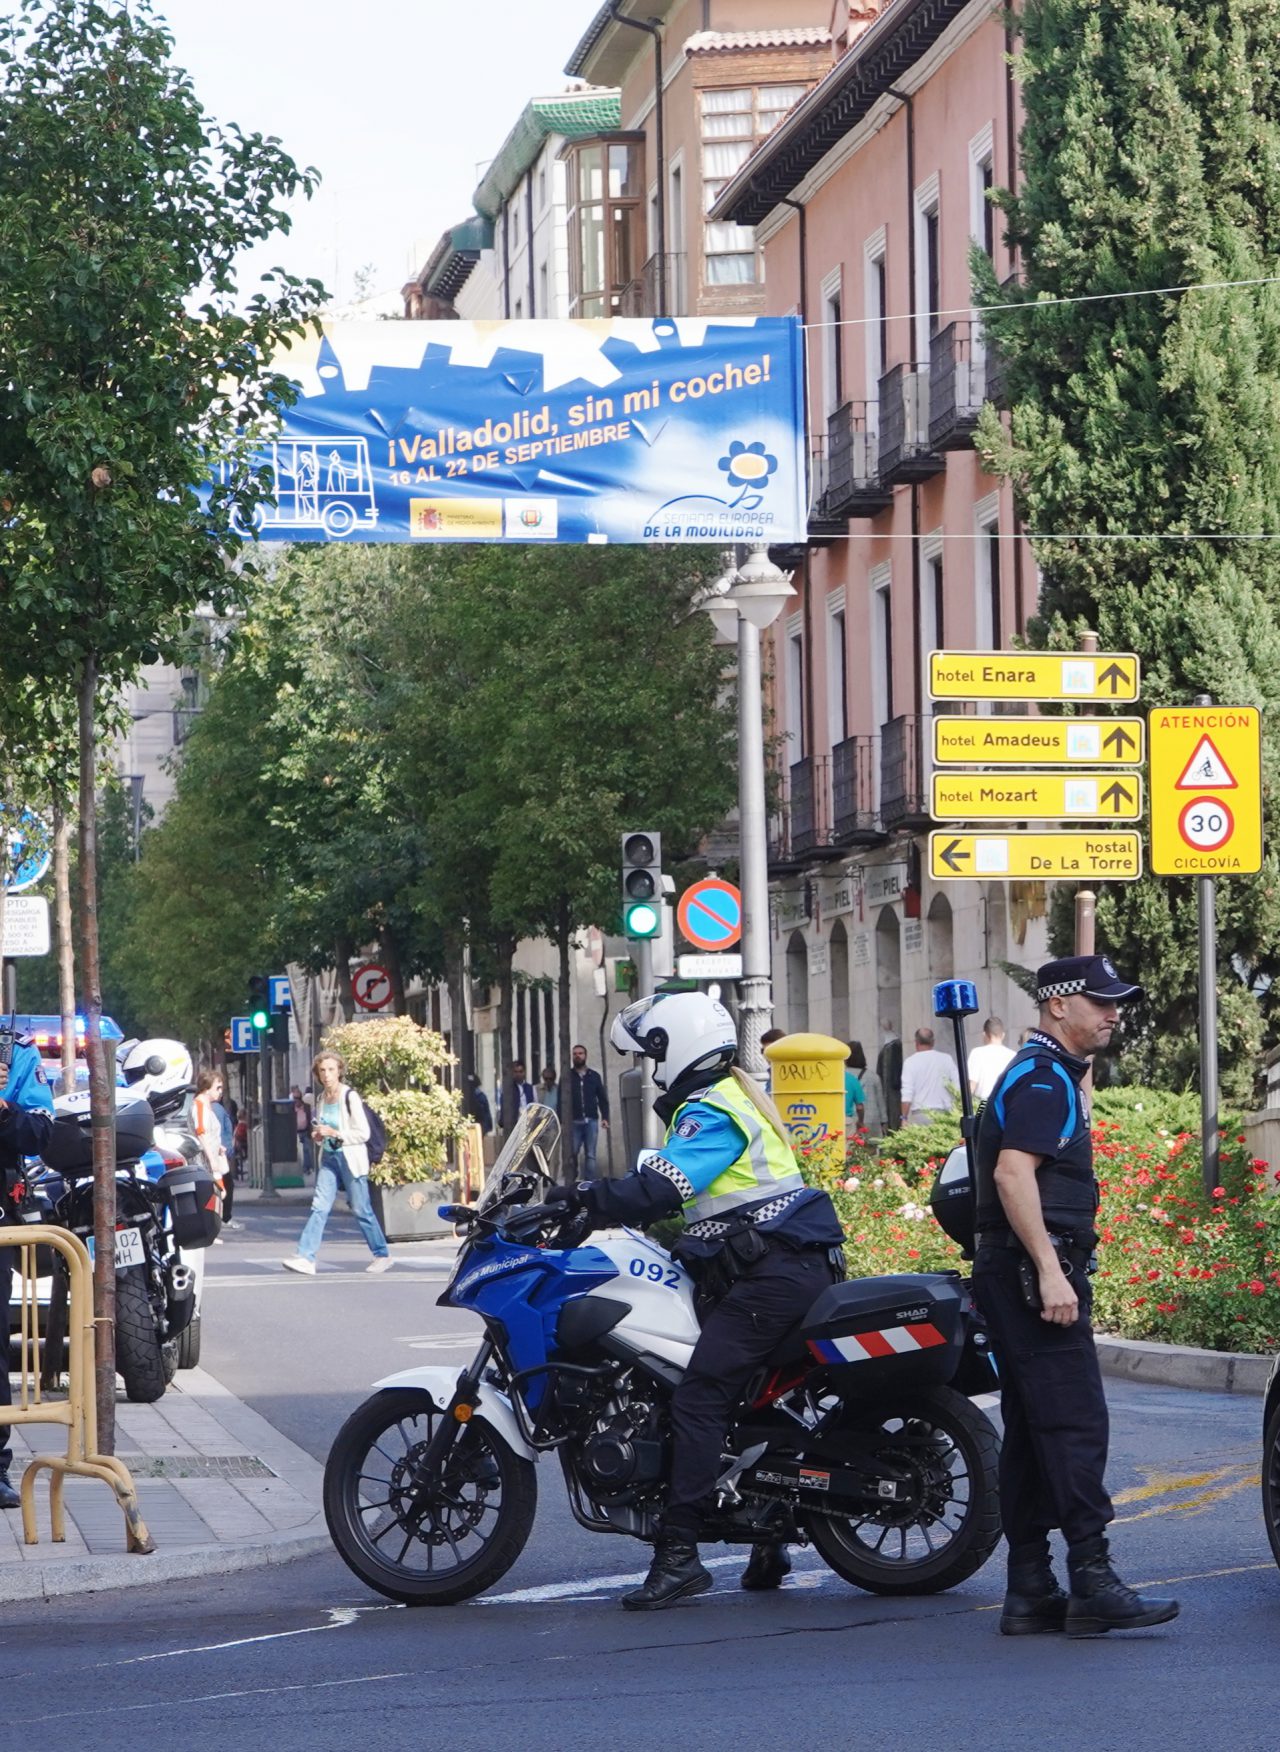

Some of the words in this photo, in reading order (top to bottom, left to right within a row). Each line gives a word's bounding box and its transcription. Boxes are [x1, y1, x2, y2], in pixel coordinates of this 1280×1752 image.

[388, 406, 558, 467] ¡Valladolid,
[568, 396, 613, 426] sin
[623, 380, 660, 414] mi
[669, 354, 771, 403] coche!
[390, 471, 411, 486] 16
[415, 465, 441, 483] AL
[446, 458, 468, 478] 22
[472, 451, 500, 472] DE
[504, 421, 631, 465] SEPTIEMBRE
[664, 512, 713, 525] SEMANA
[719, 512, 774, 525] EUROPEA
[643, 526, 660, 537] DE
[665, 526, 681, 537] LA
[686, 526, 764, 537] MOVILIDAD
[936, 669, 975, 682] hotel
[982, 667, 1036, 682] Enara
[1160, 712, 1250, 729] ATENCIÓN
[941, 735, 976, 746] hotel
[983, 732, 1060, 747] Amadeus
[939, 791, 973, 802] hotel
[980, 788, 1038, 802] Mozart
[1190, 814, 1223, 833] 30
[1085, 841, 1133, 853] hostal
[1030, 856, 1052, 869] De
[1061, 856, 1080, 869] La
[1089, 856, 1133, 869] Torre
[1174, 856, 1240, 869] CICLOVÍA
[883, 876, 901, 897] PIEL
[480, 1254, 529, 1277] Municipal
[629, 1258, 682, 1290] 092
[895, 1307, 929, 1320] SHAD
